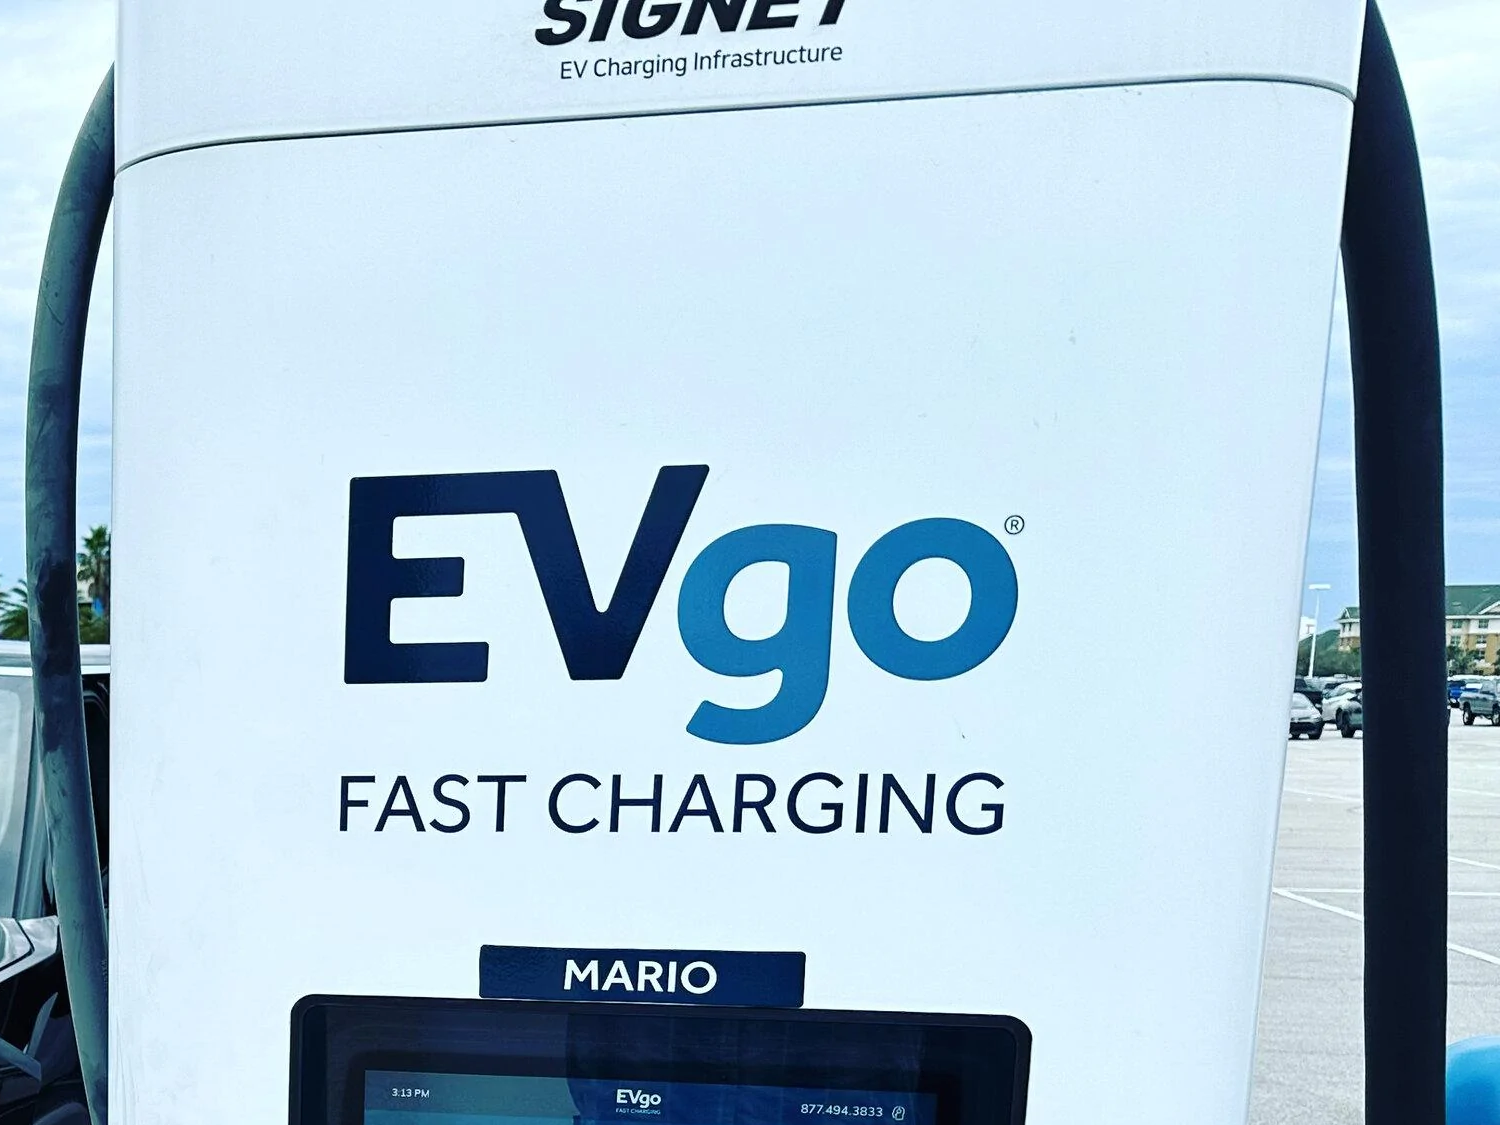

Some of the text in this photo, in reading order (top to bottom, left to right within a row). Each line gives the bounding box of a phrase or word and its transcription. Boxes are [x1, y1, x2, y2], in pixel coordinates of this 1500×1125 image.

[560, 46, 843, 79] EV Charging Infrastructure
[344, 464, 1019, 745] EVgo
[339, 772, 1005, 836] FAST CHARGING
[563, 959, 718, 994] MARIO
[392, 1088, 430, 1098] 3:13 PM
[616, 1089, 662, 1108] EVgo
[800, 1104, 883, 1118] 877.494.3833
